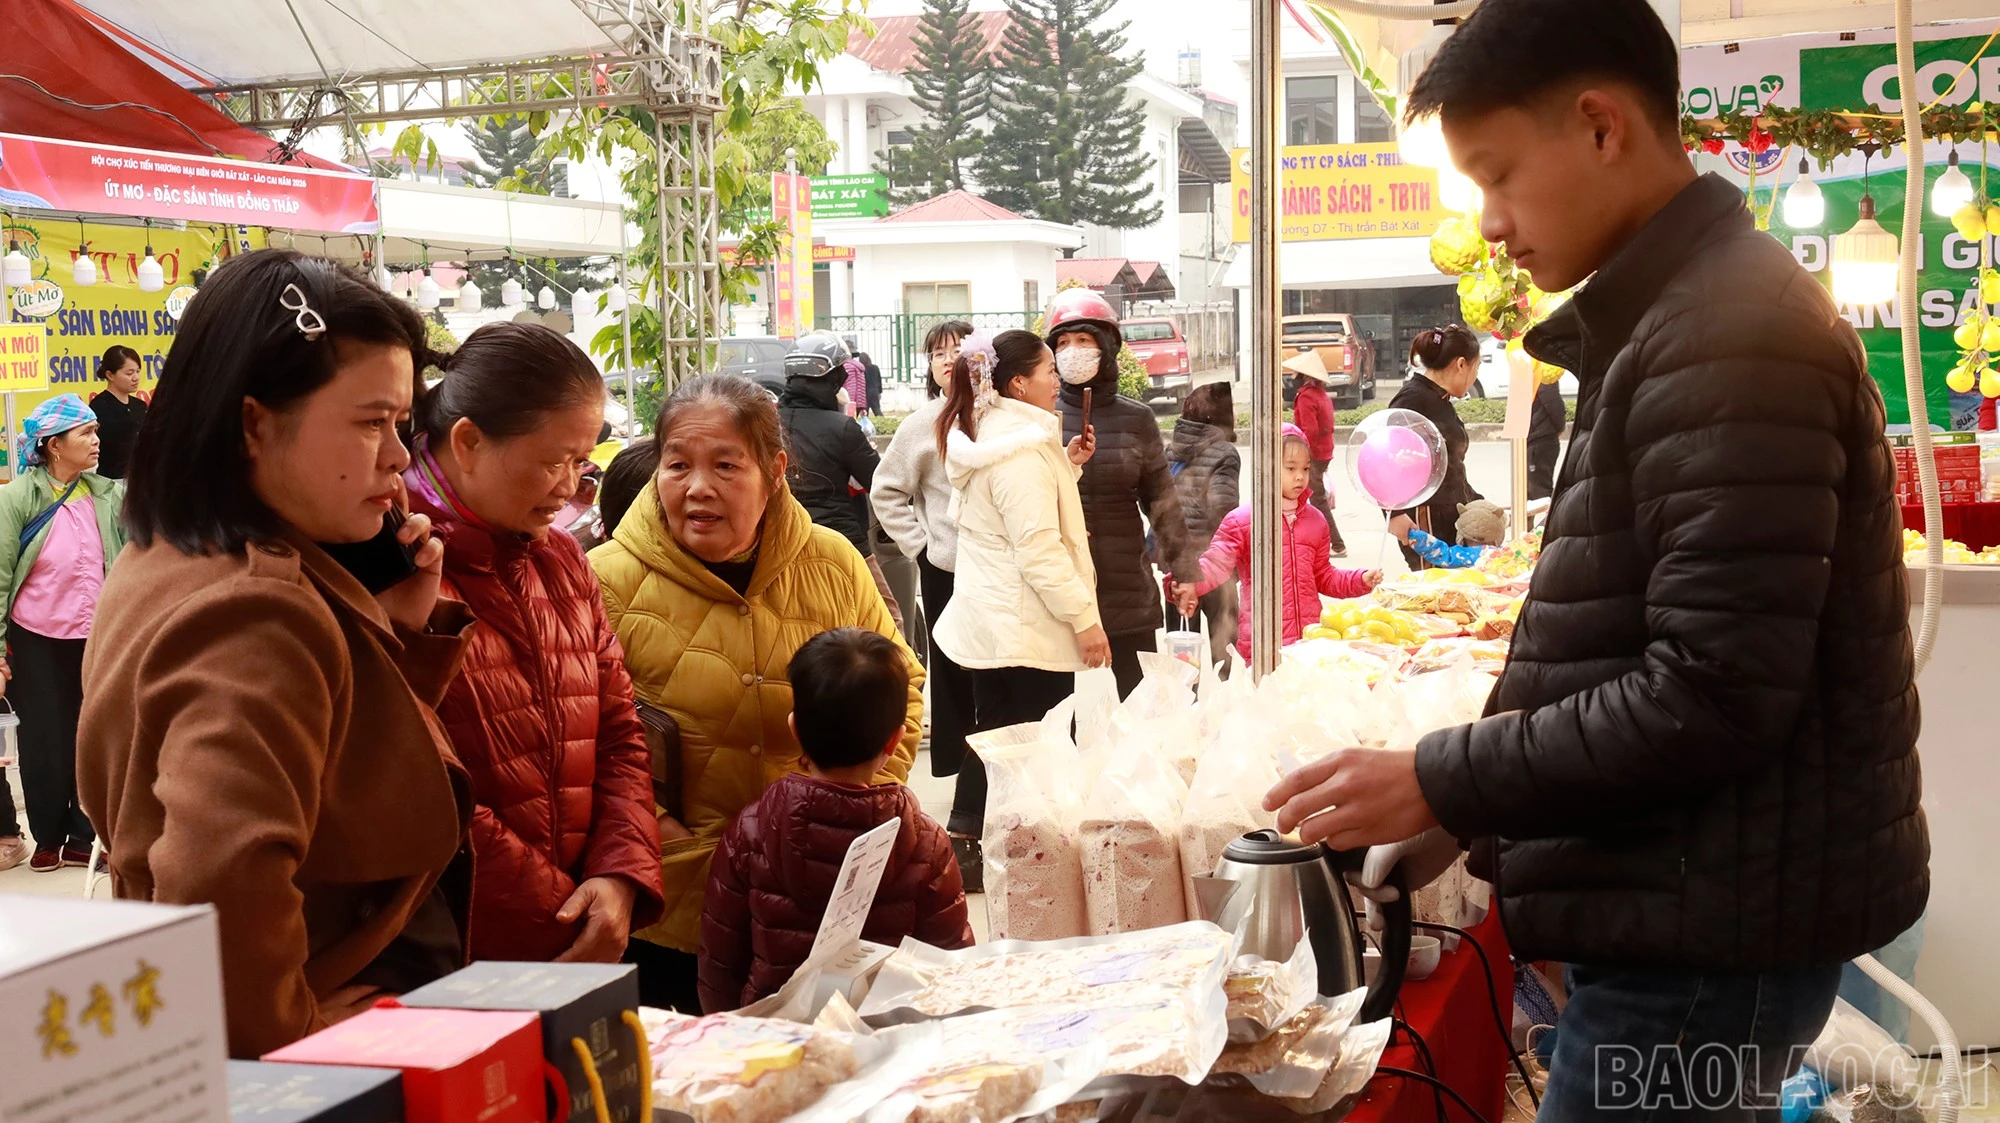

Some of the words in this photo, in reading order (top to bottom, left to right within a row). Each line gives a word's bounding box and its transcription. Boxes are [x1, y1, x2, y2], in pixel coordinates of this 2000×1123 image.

[91, 154, 105, 167] HỘI
[106, 157, 123, 169] CHỢ
[123, 158, 139, 169] XÚC
[139, 159, 154, 171] TIẾN
[154, 162, 182, 174] THƯƠNG
[182, 166, 196, 177] MẠI
[238, 171, 250, 181] XÁT
[253, 173, 266, 184] LÀO
[267, 175, 278, 185] CAI
[278, 176, 292, 187] NĂM
[1301, 156, 1317, 169] TY
[1319, 155, 1334, 169] CP
[1337, 151, 1367, 168] SÁCH
[104, 178, 119, 198] ÚT
[122, 184, 144, 200] MƠ
[153, 184, 181, 206] ĐẶC
[183, 185, 208, 206] SẢN
[208, 188, 236, 208] TỈNH
[237, 189, 271, 211] ĐỒNG
[272, 195, 300, 214] THÁP
[811, 189, 836, 200] BÁT
[840, 188, 867, 199] XÁT
[1327, 178, 1372, 215] SÁCH
[1388, 182, 1430, 213] TBTH
[1312, 223, 1328, 234] D7
[1338, 222, 1353, 233] Thị
[1942, 231, 2000, 270] GI
[18, 290, 33, 308] Út
[38, 288, 59, 303] Mơ
[58, 301, 96, 336] SẢN
[100, 304, 149, 336] BÁNH
[11, 332, 39, 354] MỜI
[11, 355, 39, 379] THỬ
[50, 348, 87, 383] SẢN
